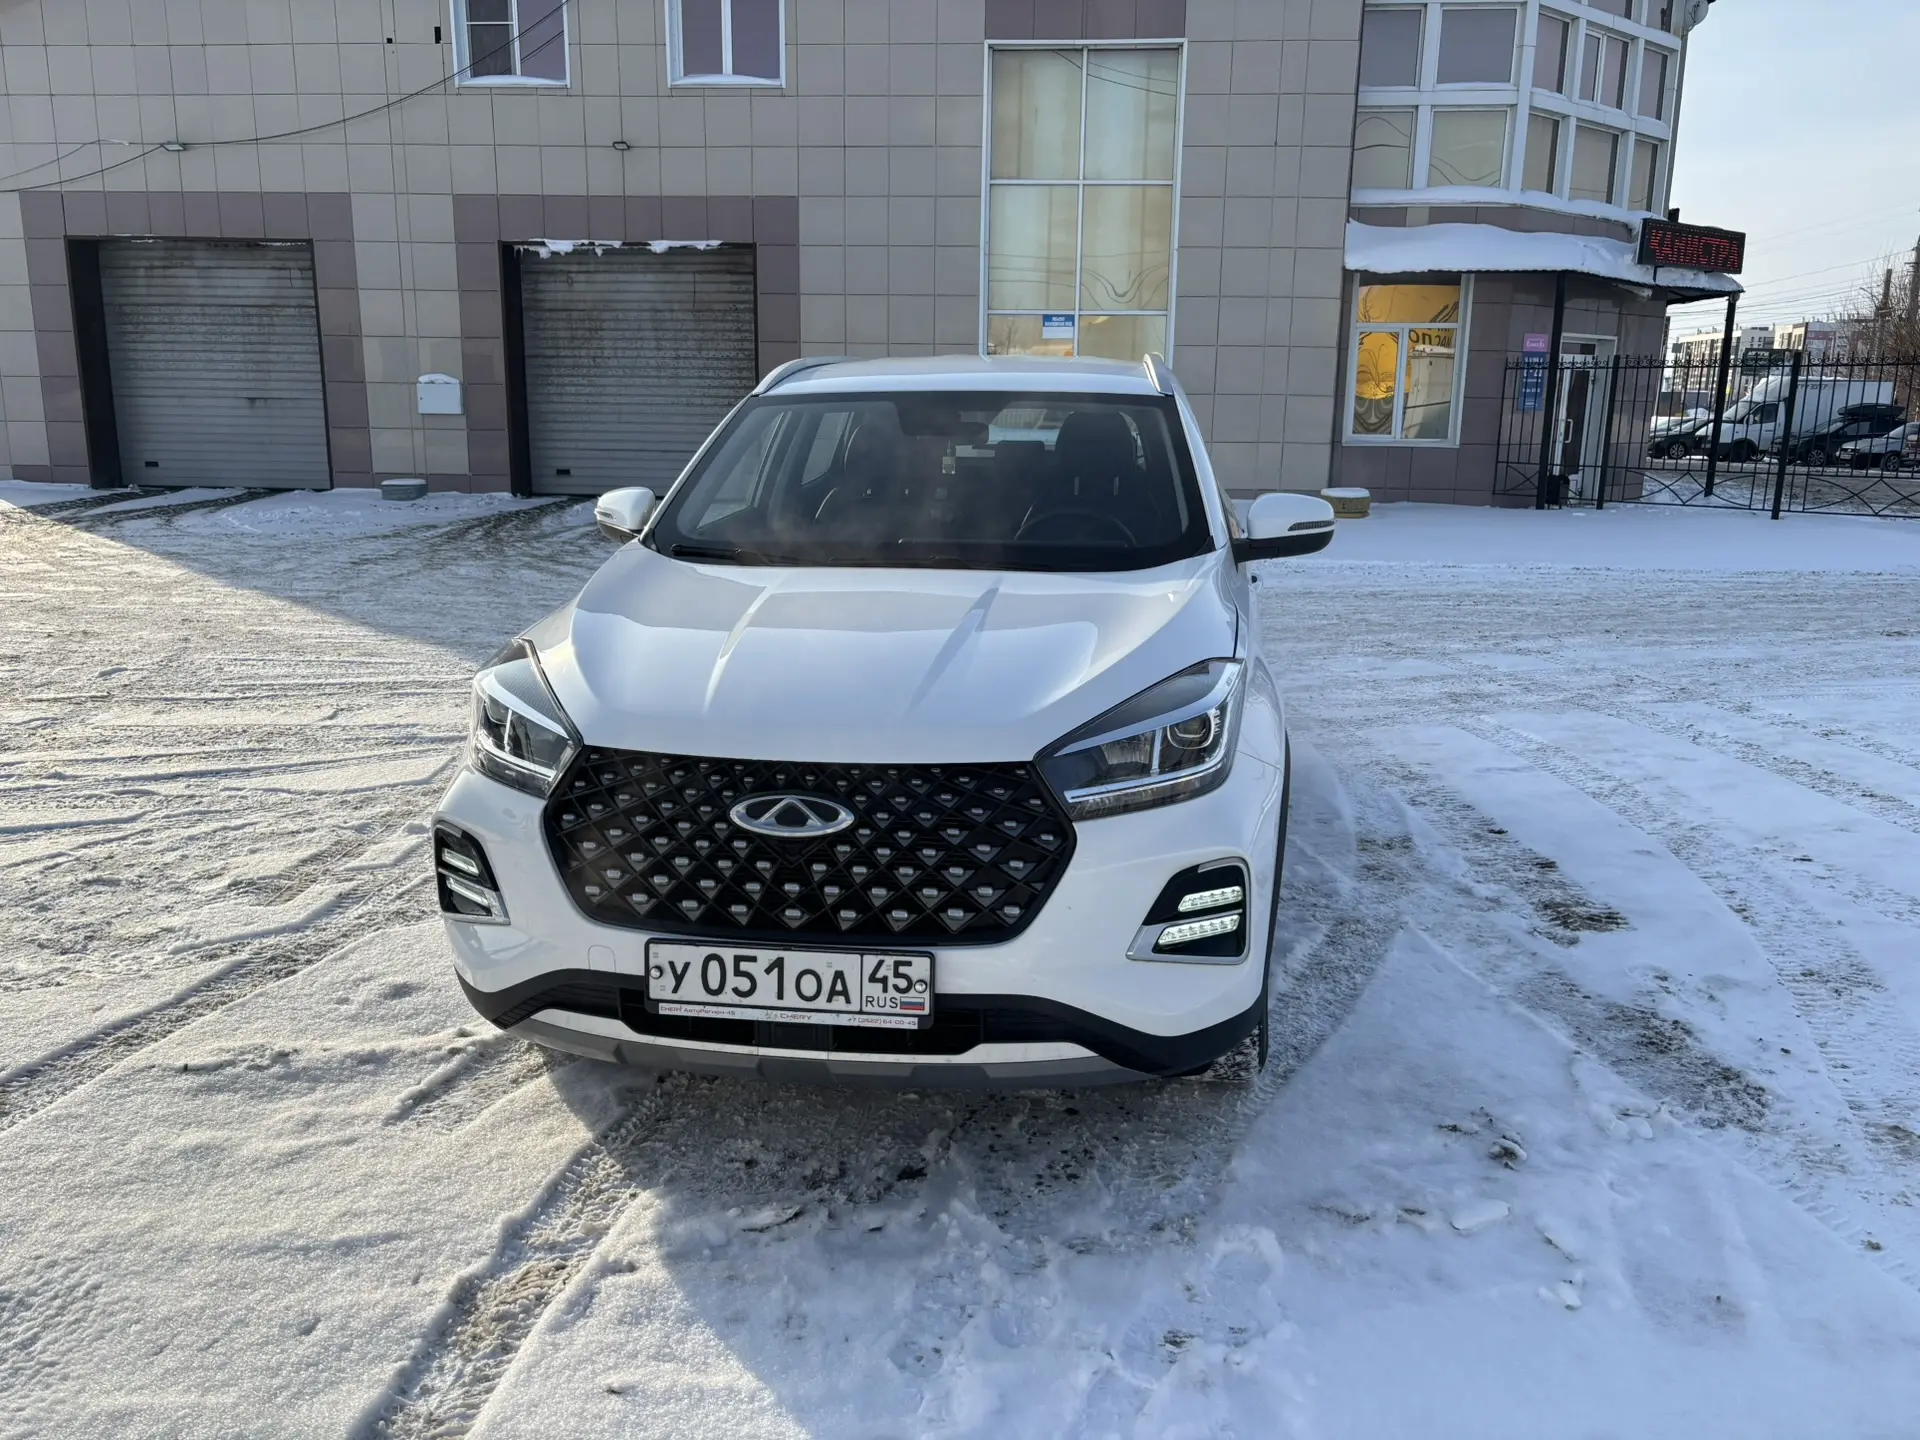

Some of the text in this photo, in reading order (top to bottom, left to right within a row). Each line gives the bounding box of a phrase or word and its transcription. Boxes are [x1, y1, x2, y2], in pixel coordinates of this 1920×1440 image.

[868, 959, 914, 994] 45
[865, 995, 898, 1009] RUS
[779, 1012, 813, 1021] CHERY
